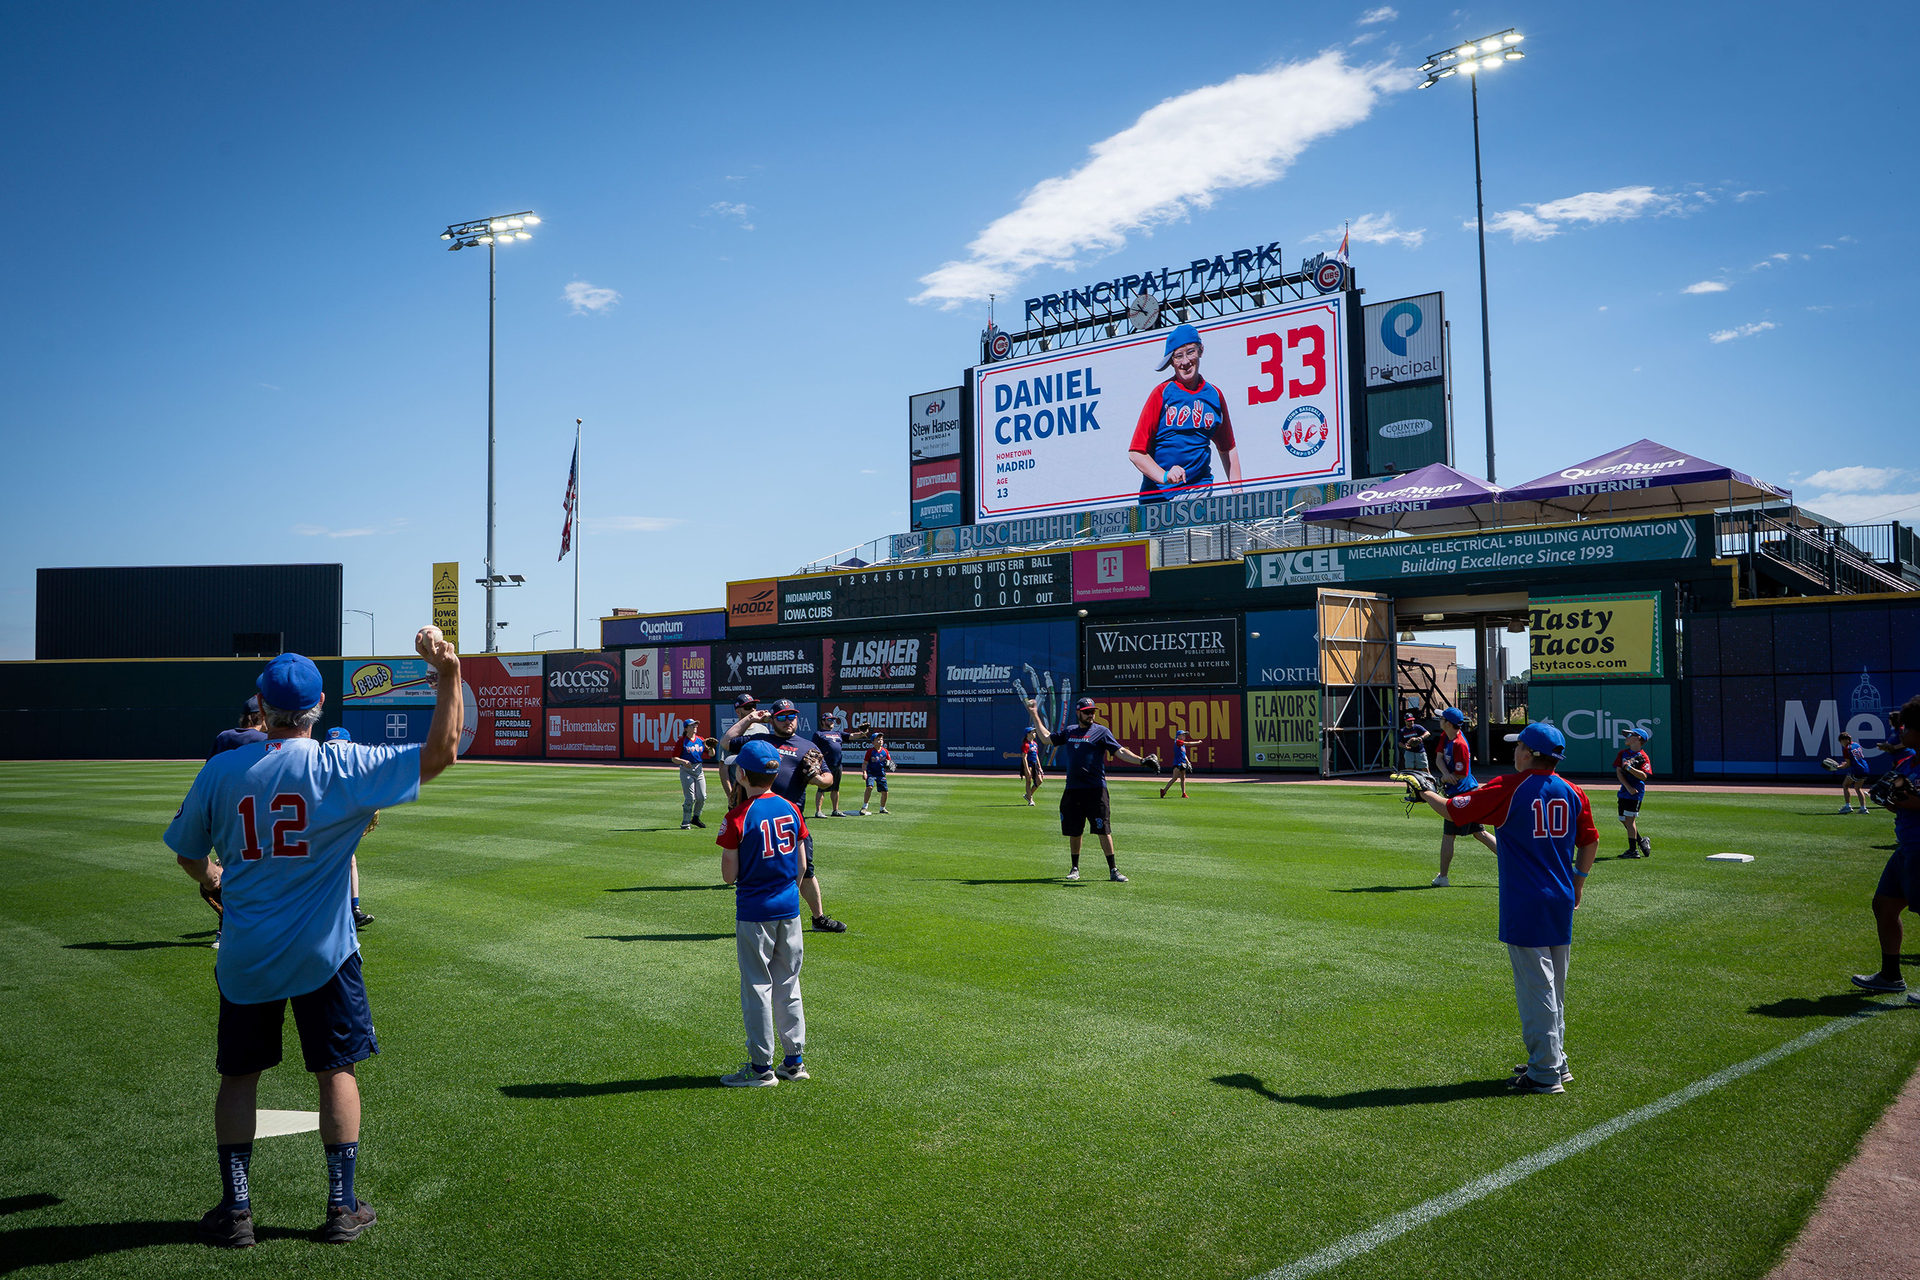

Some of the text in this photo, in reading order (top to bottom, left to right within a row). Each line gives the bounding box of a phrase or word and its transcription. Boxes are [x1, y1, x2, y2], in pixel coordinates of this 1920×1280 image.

[1024, 241, 1280, 321] PRINCIPAL PARK
[1246, 324, 1327, 406] 33
[995, 367, 1101, 413] DANIEL
[912, 418, 960, 437] Stew Hansen
[995, 401, 1101, 445] CRONK
[1386, 421, 1425, 433] COUNTRY
[996, 449, 1032, 460] HOMETOWN
[996, 459, 1036, 473] MADRID
[1560, 459, 1686, 480] Quantum
[996, 477, 1008, 485] AGE
[1568, 477, 1653, 496] INTERNET
[996, 488, 1009, 499] 13
[1357, 483, 1463, 502] Quantum
[920, 503, 954, 517] ADVENTURE
[1146, 490, 1287, 531] BUSCHHHHH
[1359, 500, 1431, 516] INTERNET
[1092, 510, 1129, 526] BUSCH
[893, 534, 925, 551] BUSCH
[1348, 545, 1425, 560] MECHANICAL
[1514, 530, 1578, 547] BUILDING
[1581, 522, 1678, 541] AUTOMATION
[1261, 548, 1345, 587] EXCEL
[1401, 545, 1614, 574] Building Excellence Since 1993
[838, 557, 1052, 586] 1 2 3 4 5 6 7 8 9 10 RUNS HITS ERR BALL
[1290, 572, 1344, 583] MECHANICAL INC.
[785, 572, 1053, 603] INDIANAPOLIS 0 0 0 STRIKE
[434, 608, 456, 617] Iowa
[731, 601, 774, 615] HOODZ
[784, 590, 1053, 621] IOWA CUBS 0 0 0 OUT
[434, 618, 456, 627] State
[640, 620, 683, 637] Quantum
[1528, 608, 1613, 635] Tasty
[442, 627, 456, 636] ank
[1096, 631, 1224, 653] WINCHESTER
[1530, 633, 1615, 656] Tacos
[683, 657, 705, 670] FLAVOR
[747, 649, 804, 662] PLUMBERS &
[549, 669, 609, 687] access
[682, 669, 705, 679] RUNS
[746, 663, 815, 676] STEAMFITTERS
[879, 660, 891, 680] &
[946, 664, 1011, 682] Tompkins
[356, 666, 388, 696] B-Bop's
[631, 669, 650, 690] LOLA'S
[682, 679, 706, 687] IN THE
[479, 685, 530, 696] KNOCKING IT
[682, 687, 705, 695] FAMILY
[479, 697, 541, 708] OUT OF THE PARK
[1255, 695, 1316, 717] FLAVOR'S
[495, 710, 521, 718] RELIABLE,
[851, 711, 928, 729] CEMENTECH
[1094, 700, 1231, 740] SIMPSON
[495, 720, 531, 728] AFFORDABLE,
[562, 719, 616, 732] Homemakers
[1255, 719, 1318, 742] WAITING.
[495, 730, 529, 738] RENEWABLE
[906, 742, 926, 750] Trucks
[237, 792, 310, 861] 12
[1531, 798, 1569, 839] 10
[760, 814, 796, 859] 15
[231, 1151, 250, 1201] RESPECT
[330, 1180, 343, 1201] THE
